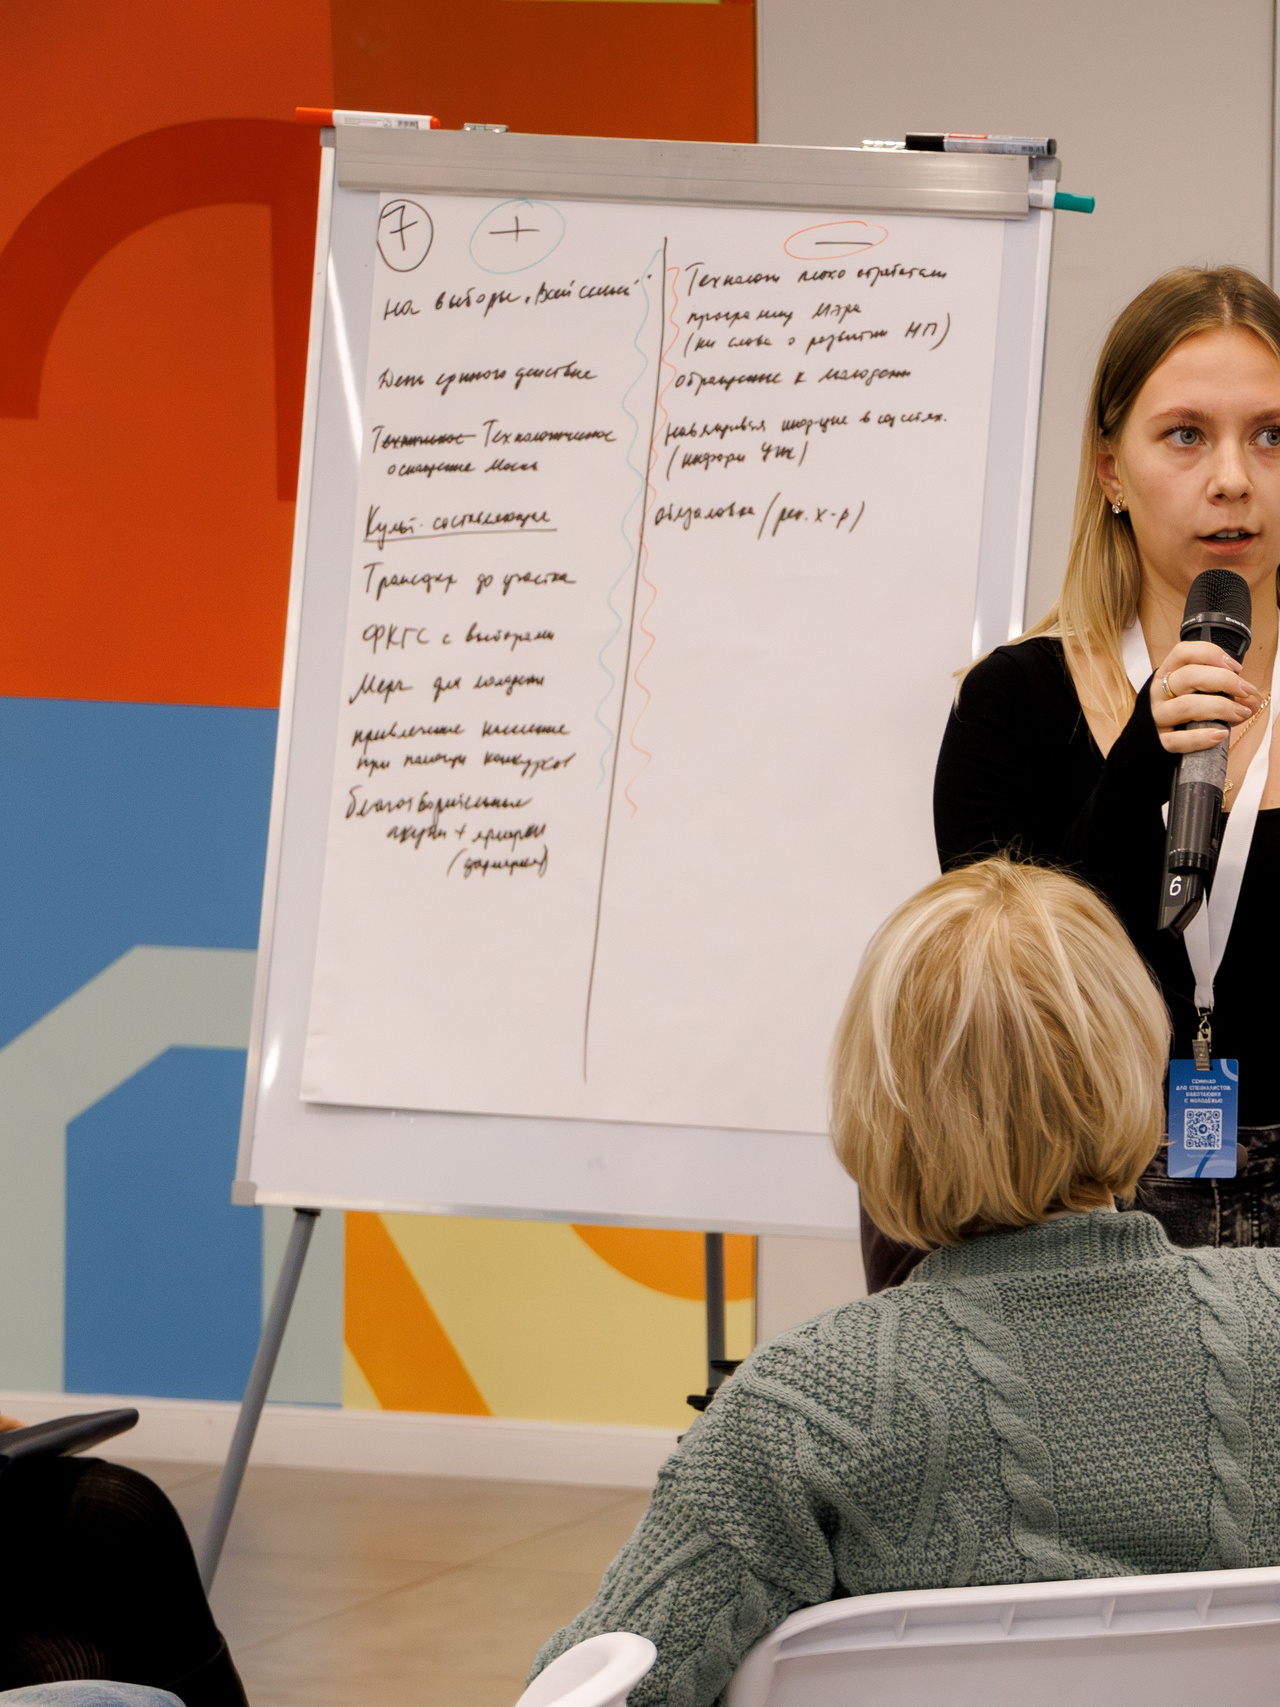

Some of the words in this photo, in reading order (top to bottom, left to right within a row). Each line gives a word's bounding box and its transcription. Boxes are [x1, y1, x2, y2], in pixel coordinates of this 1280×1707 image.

[727, 334, 772, 348] слова
[378, 367, 425, 389] День
[476, 573, 493, 595] до
[433, 676, 461, 704] для
[1169, 875, 1182, 896] 6
